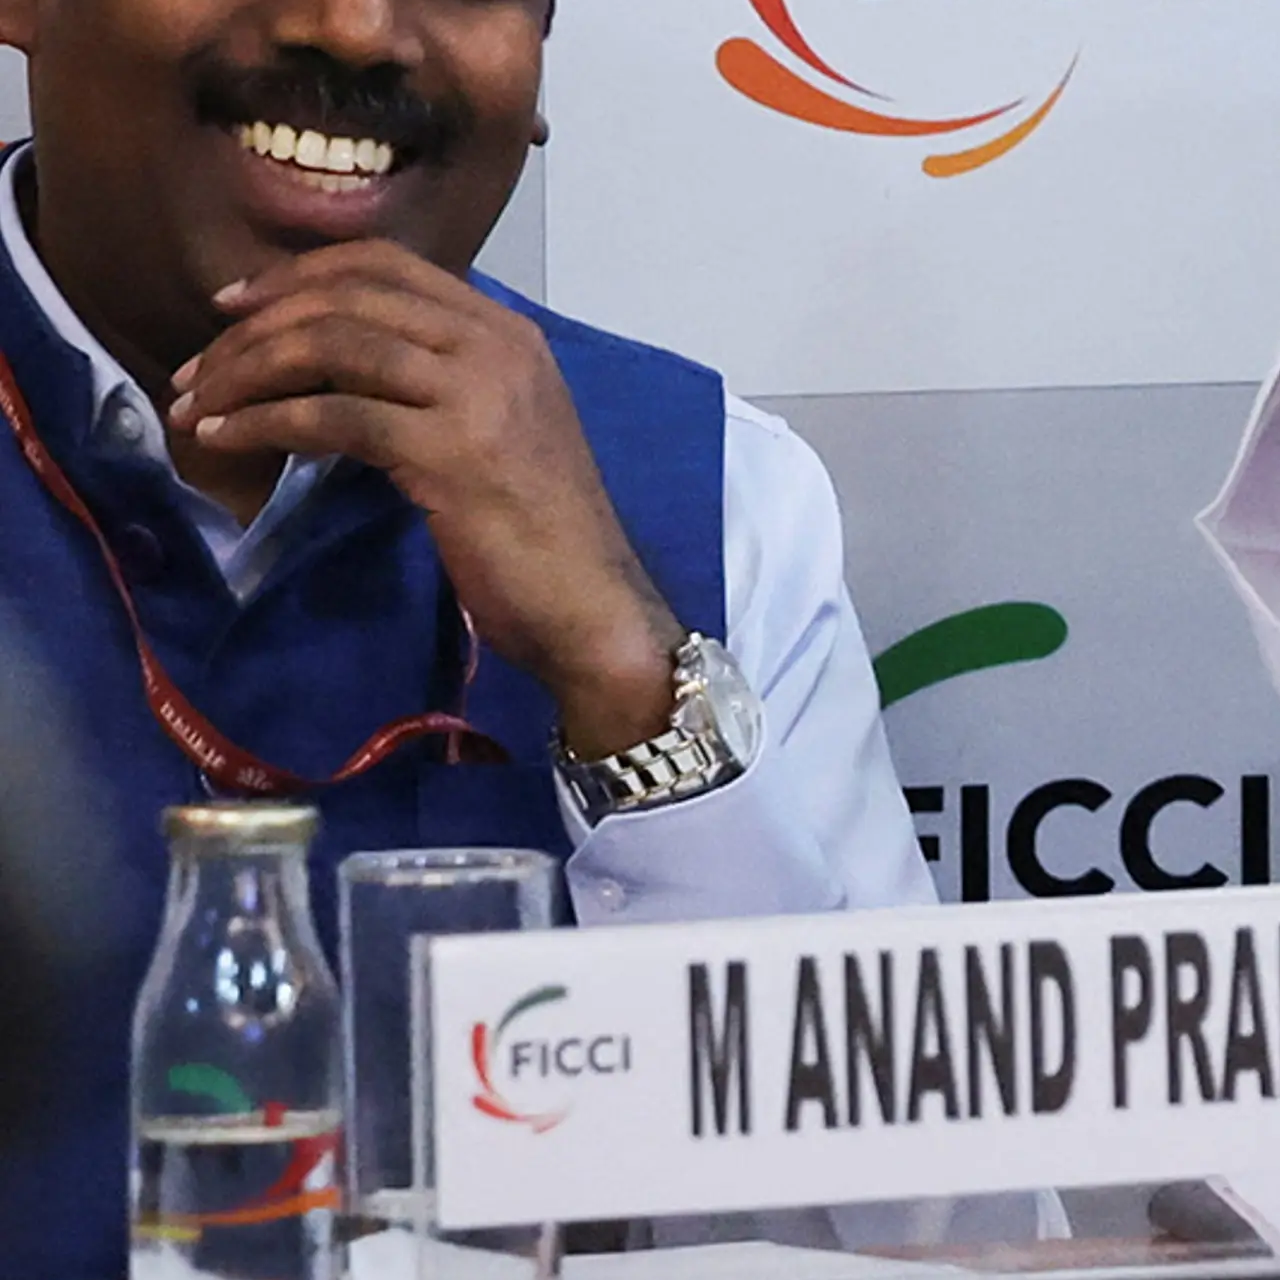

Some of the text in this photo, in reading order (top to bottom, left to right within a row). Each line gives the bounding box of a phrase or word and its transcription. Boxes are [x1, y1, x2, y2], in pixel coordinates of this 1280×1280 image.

[510, 1035, 631, 1078] FICCI
[688, 961, 752, 1138] M
[784, 940, 1077, 1132] ANAND
